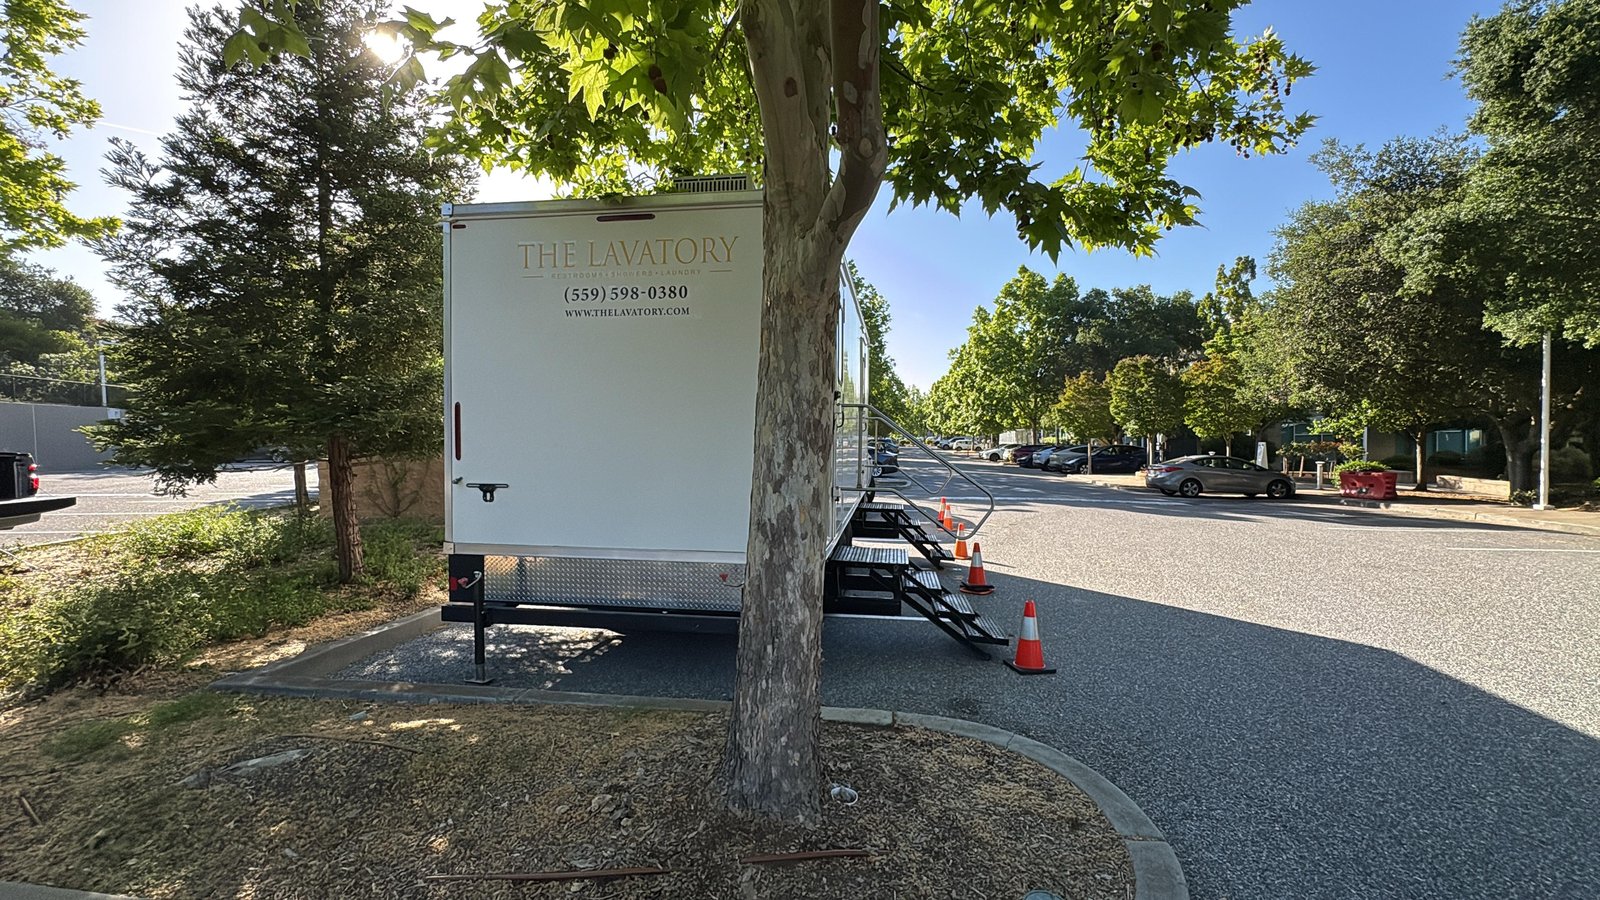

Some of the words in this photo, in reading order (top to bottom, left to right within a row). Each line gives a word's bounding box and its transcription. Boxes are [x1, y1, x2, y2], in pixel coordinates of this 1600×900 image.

[517, 240, 577, 270] THE
[588, 236, 739, 267] LAVATORY
[660, 269, 702, 277] LAUNDRY
[563, 286, 606, 303] (559)
[610, 285, 688, 301] 598-0380
[564, 307, 690, 317] WWW.THELAVATORY.COM
